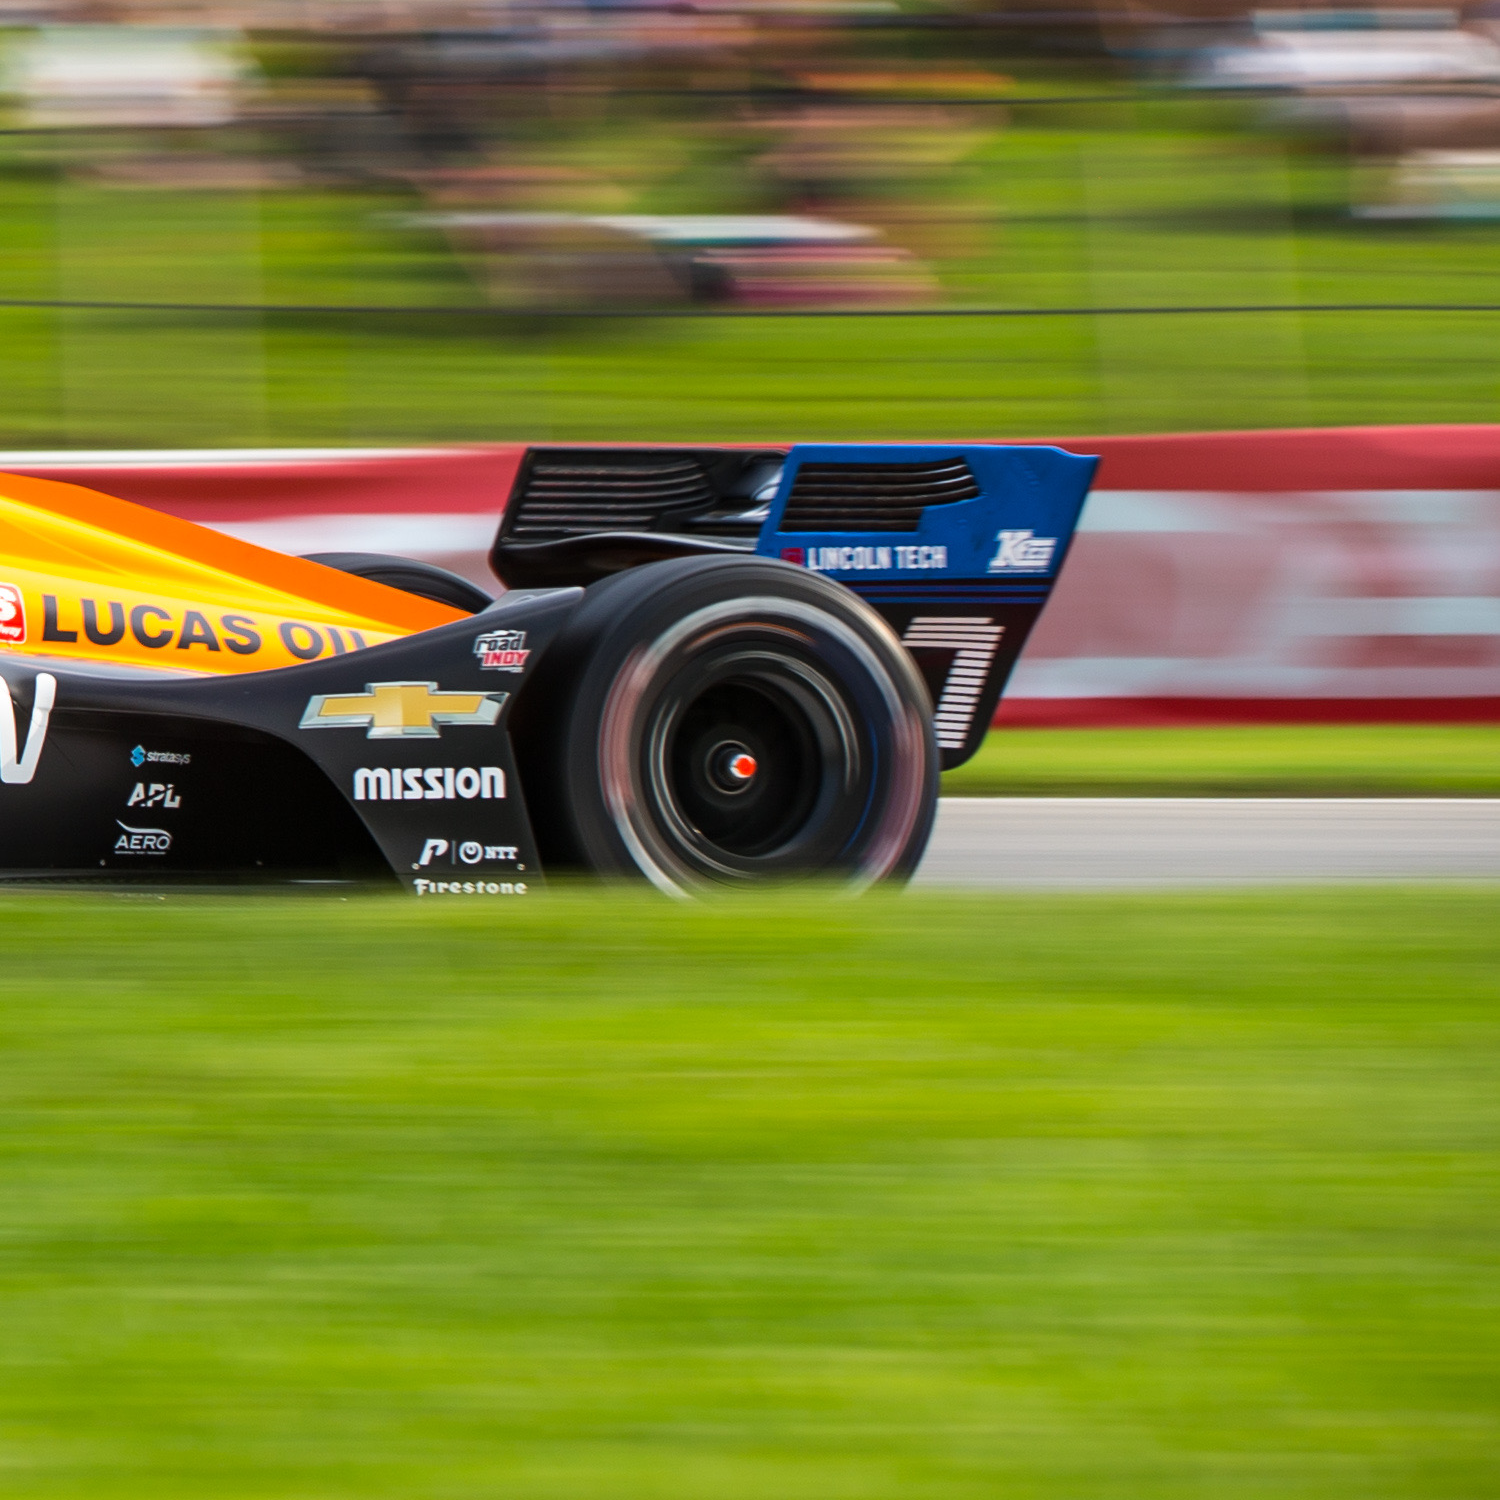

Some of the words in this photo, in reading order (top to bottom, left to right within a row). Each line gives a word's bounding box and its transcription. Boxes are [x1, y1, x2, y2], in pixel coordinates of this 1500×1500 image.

[807, 546, 892, 570] LINCOLN
[895, 545, 948, 569] TECH
[42, 593, 262, 656] LUCAS
[483, 650, 530, 666] INDY
[900, 616, 1006, 749] 7
[146, 751, 191, 765] stratasys
[115, 834, 171, 850] AERO
[484, 846, 518, 860] NTT
[412, 878, 528, 896] Firestone
